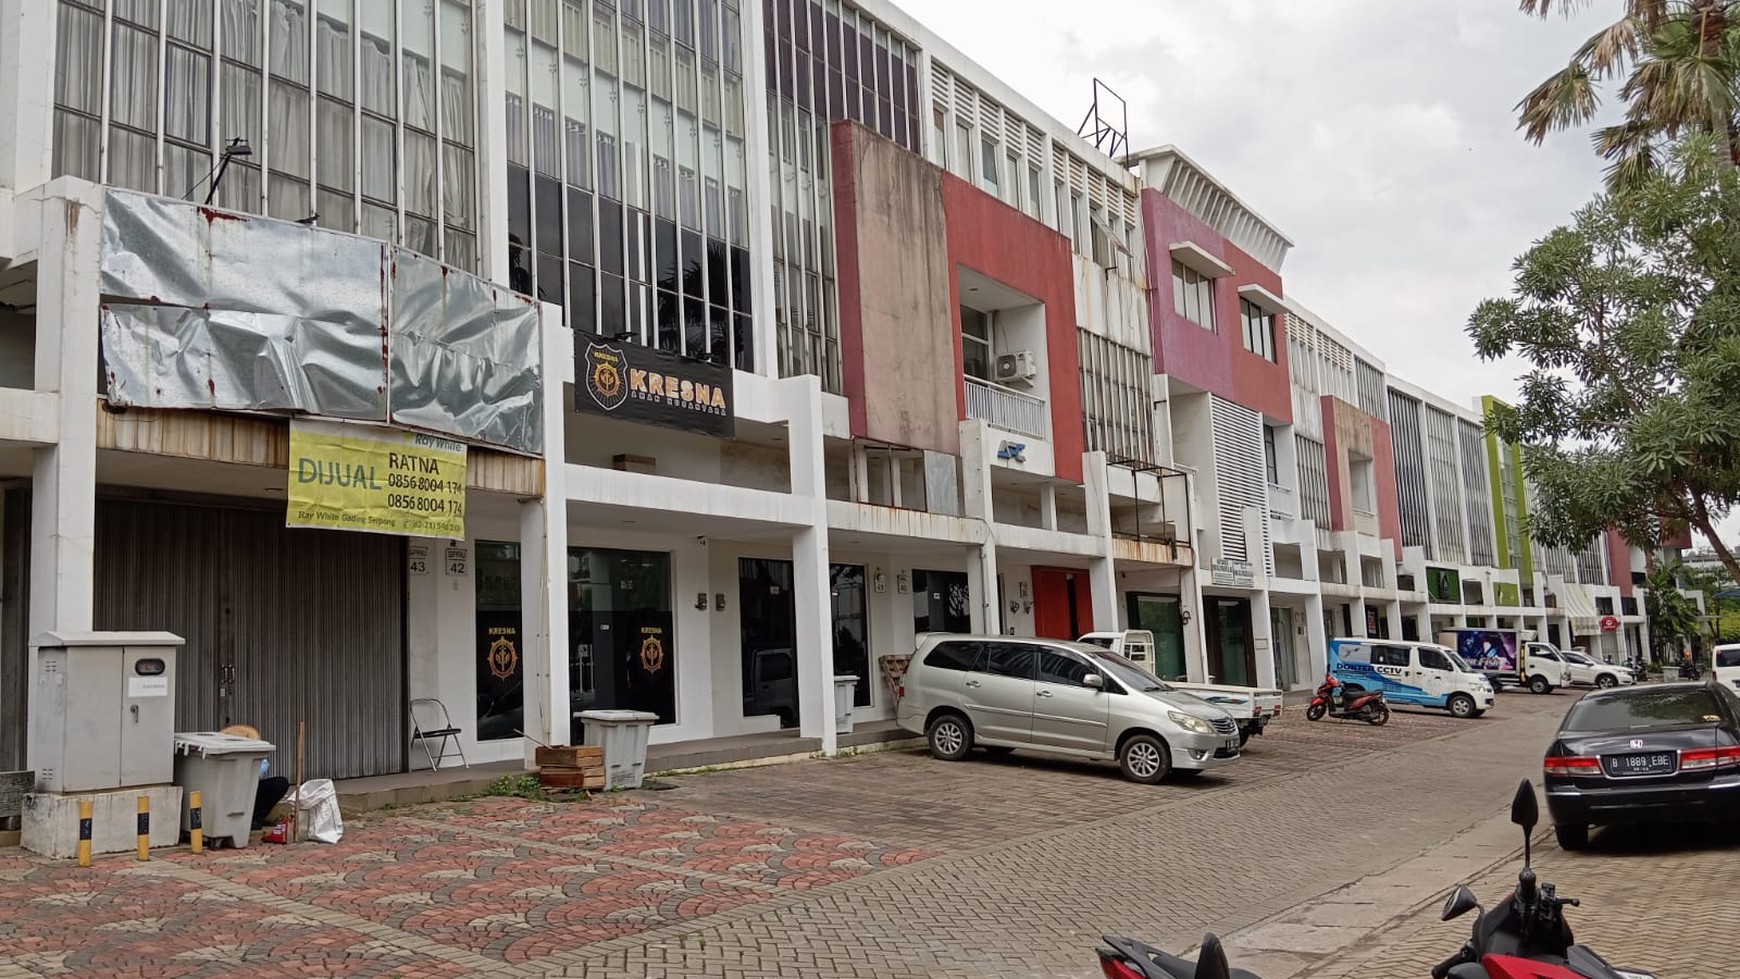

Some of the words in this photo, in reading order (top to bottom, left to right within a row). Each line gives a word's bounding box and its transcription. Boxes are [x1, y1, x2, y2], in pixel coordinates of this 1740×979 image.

[630, 368, 726, 409] KRESNA
[415, 433, 434, 448] Ray
[436, 438, 462, 452] White
[389, 452, 440, 475] RATNA
[298, 457, 382, 490] DIJUAL
[388, 473, 416, 489] 0856
[418, 477, 444, 493] 8004
[388, 493, 415, 509] 0856
[417, 497, 445, 513] 8004
[298, 511, 314, 521] Ray
[316, 511, 340, 521] White
[342, 513, 366, 524] Gading
[410, 562, 426, 573] 43
[450, 562, 465, 573] 42
[488, 627, 516, 635] KRESNA
[1336, 663, 1375, 672] DOKTER
[1377, 666, 1402, 674] CCTV
[1612, 758, 1618, 767] B
[1625, 756, 1647, 767] 1889
[1651, 755, 1669, 766] EBE
